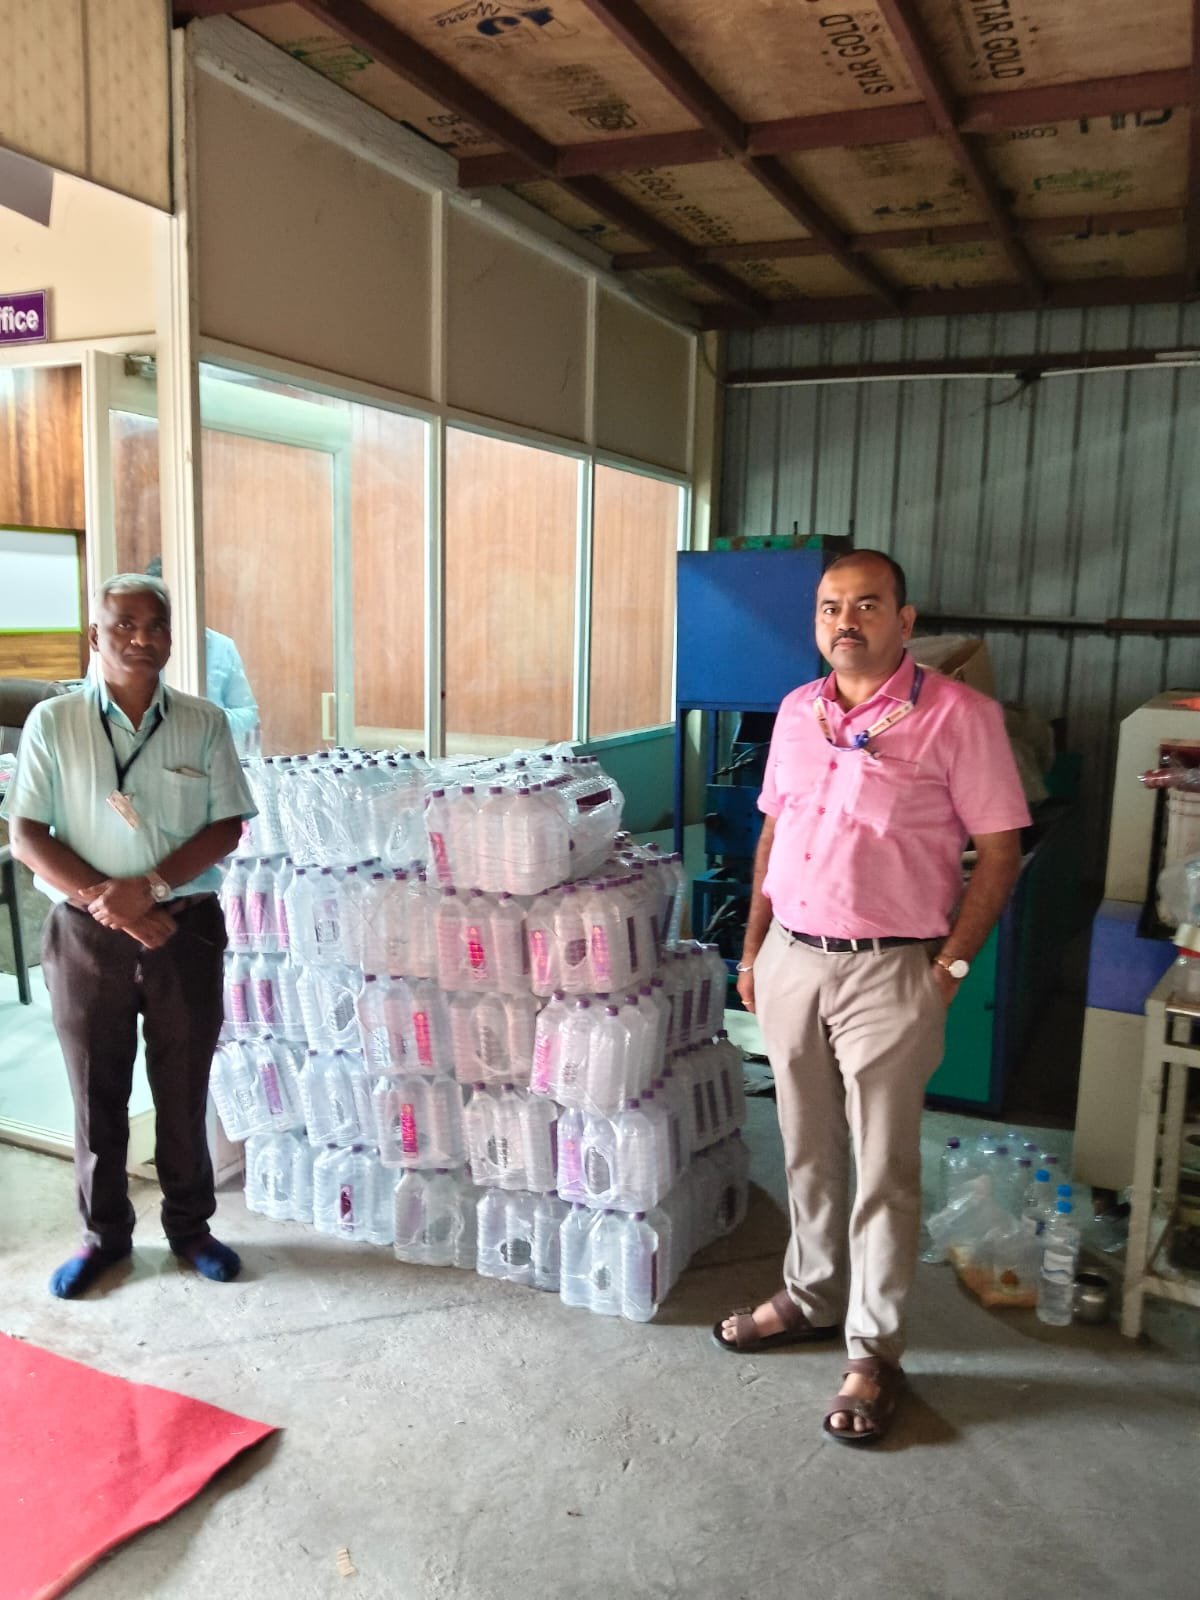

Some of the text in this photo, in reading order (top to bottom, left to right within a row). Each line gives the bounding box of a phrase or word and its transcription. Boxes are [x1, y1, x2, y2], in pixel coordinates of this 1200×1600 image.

[818, 13, 872, 58] GOLD
[847, 57, 896, 96] STAR
[983, 37, 1026, 80] GOLD
[0, 305, 39, 333] fice
